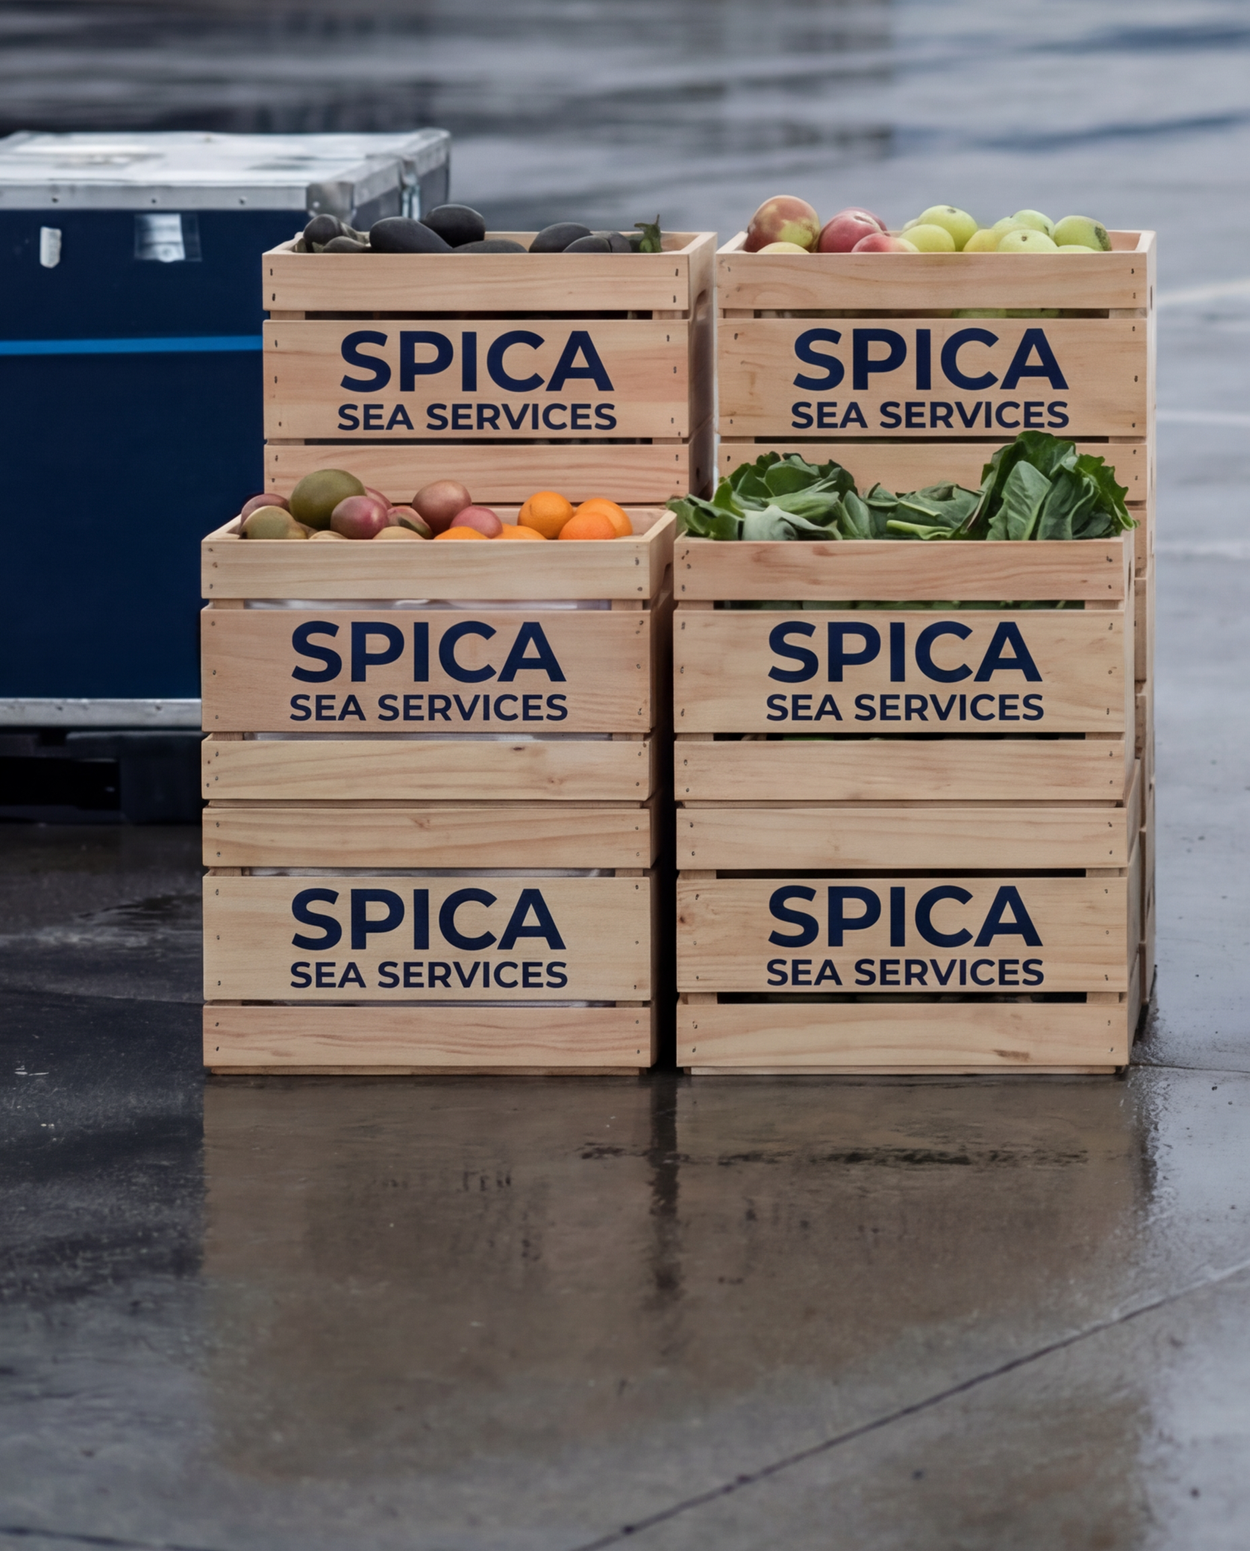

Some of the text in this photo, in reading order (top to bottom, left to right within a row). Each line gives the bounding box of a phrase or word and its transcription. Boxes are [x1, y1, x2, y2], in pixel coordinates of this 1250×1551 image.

[341, 330, 614, 392] SPICA
[793, 328, 1069, 390] SPICA
[338, 403, 617, 431] SEA SERVICES
[791, 401, 1070, 429] SEA SERVICES
[292, 620, 567, 683] SPICA
[768, 620, 1043, 683] SPICA
[290, 694, 568, 721] SEA SERVICES
[767, 694, 1044, 721] SEA SERVICES
[292, 887, 567, 950] SPICA
[768, 885, 1043, 948] SPICA
[290, 961, 568, 988] SEA SERVICES
[767, 958, 1044, 986] SEA SERVICES
